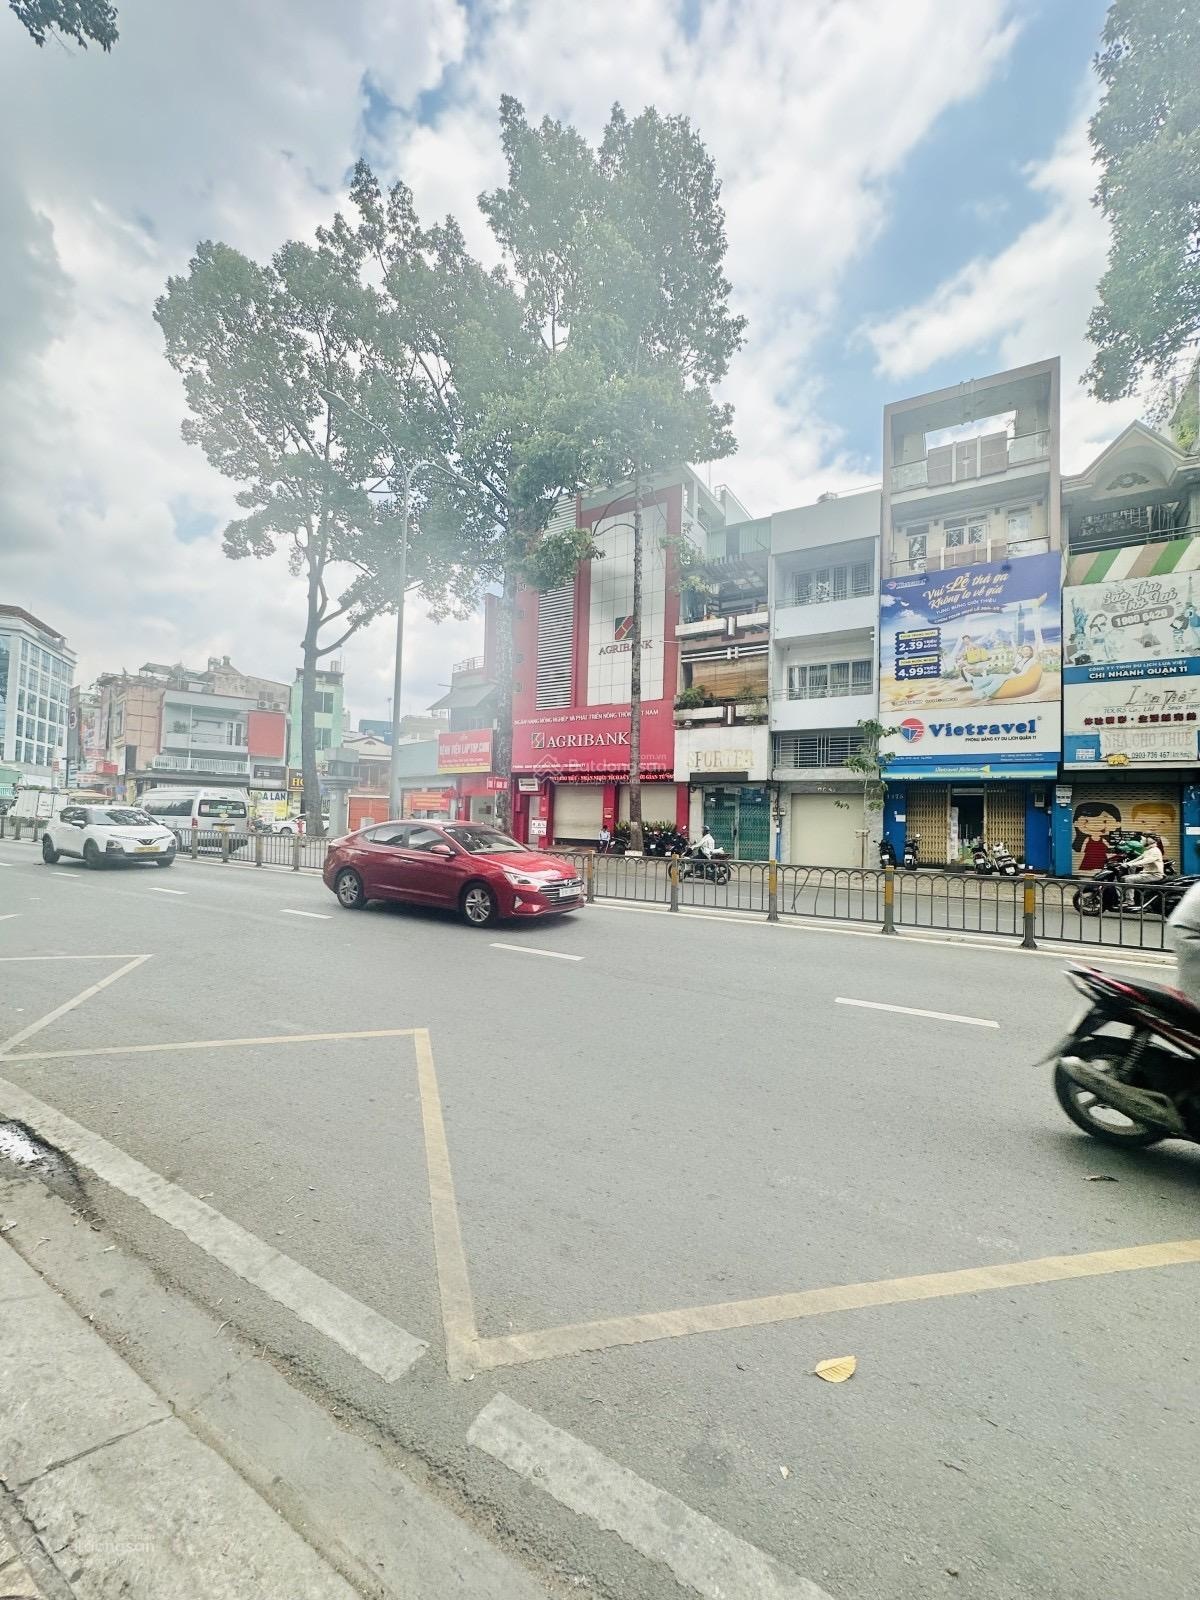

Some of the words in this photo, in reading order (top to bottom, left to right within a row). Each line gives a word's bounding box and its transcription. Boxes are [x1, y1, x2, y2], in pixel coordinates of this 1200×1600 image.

[598, 638, 653, 655] AGRIBNK
[899, 640, 923, 651] 2.39
[898, 667, 924, 677] 4.99
[1089, 672, 1105, 680] CHI
[1147, 666, 1176, 676] QUẬN
[929, 719, 1037, 738] Vietravel
[546, 731, 630, 748] AGRIBANK
[270, 792, 286, 801] LAN
